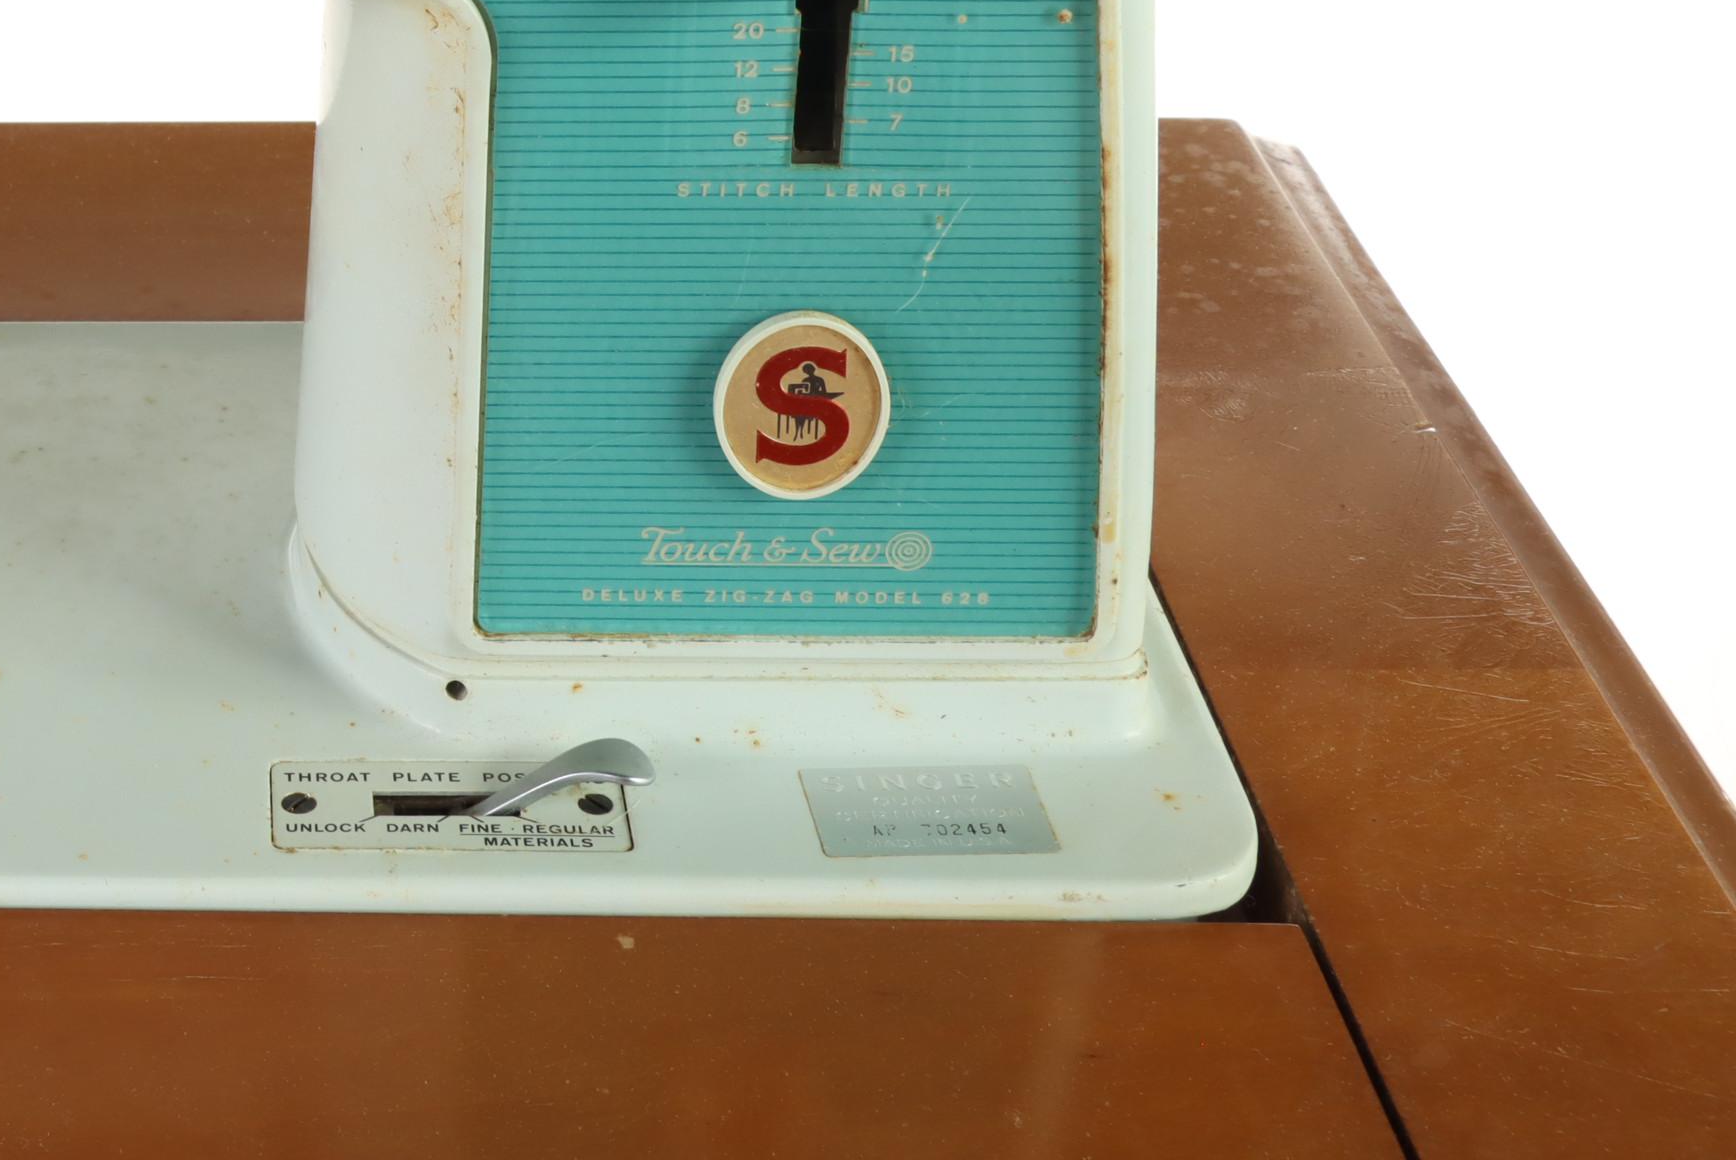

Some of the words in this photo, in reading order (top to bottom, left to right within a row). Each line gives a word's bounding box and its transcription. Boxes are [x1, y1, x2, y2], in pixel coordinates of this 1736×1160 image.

[732, 21, 765, 41] 20
[888, 45, 915, 63] 15
[734, 60, 760, 79] 12
[886, 76, 913, 95] 10
[735, 96, 752, 115] 8
[889, 113, 904, 131] 7
[732, 130, 748, 148] 6
[677, 182, 796, 198] STITCH
[825, 182, 953, 198] LENGTH
[754, 345, 850, 466] S
[640, 526, 753, 564] Touch
[763, 535, 796, 563] &
[799, 526, 883, 564] Sew
[582, 587, 684, 602] DELUXE
[704, 588, 815, 604] ZIG-ZAG
[834, 590, 922, 605] MODEL
[284, 771, 371, 783] THROAT
[392, 771, 461, 783] PLATE
[820, 771, 1015, 792] SINGER
[285, 822, 367, 834] UNLOCK
[386, 822, 440, 834] DARN
[459, 823, 503, 834] FINE
[522, 824, 615, 835] REGULAR
[483, 836, 594, 848] MATERIALS
